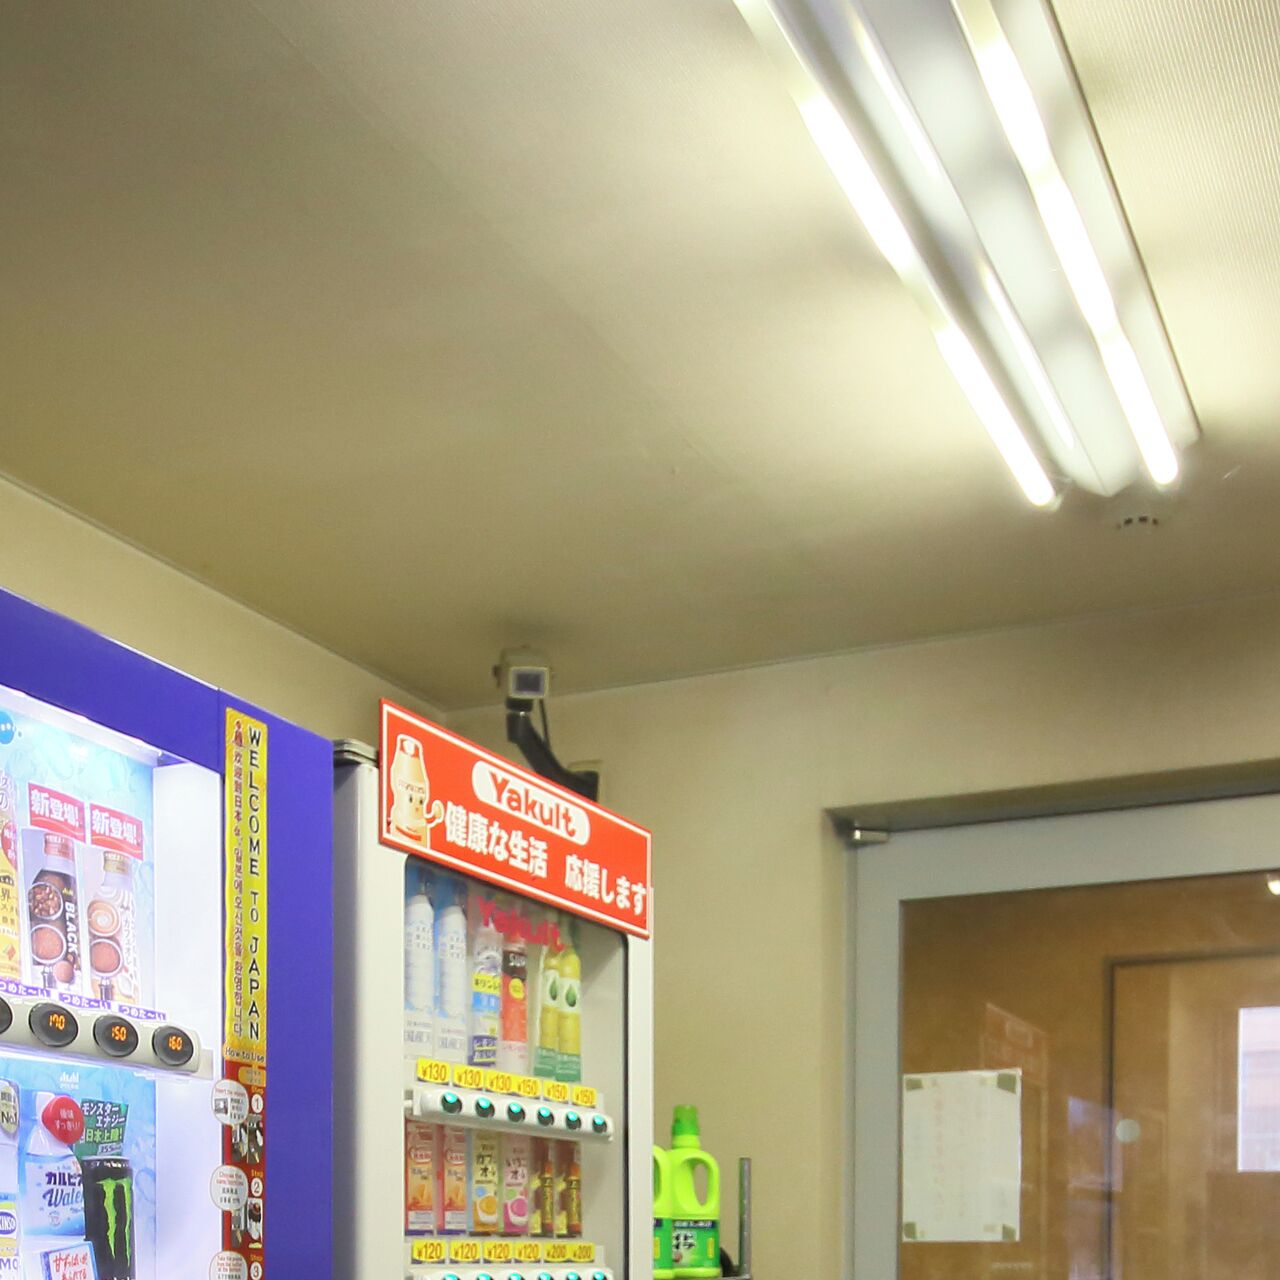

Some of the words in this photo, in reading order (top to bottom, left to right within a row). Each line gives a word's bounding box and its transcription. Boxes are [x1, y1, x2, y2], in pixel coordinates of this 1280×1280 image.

[248, 726, 262, 877] WELCOME
[488, 770, 578, 839] Yakult
[443, 801, 549, 880] 健康な生活
[564, 853, 647, 916] 応援します
[63, 900, 78, 956] BLACK
[249, 891, 260, 923] TO
[248, 936, 261, 1041] JAPAN
[109, 1025, 127, 1041] 150
[166, 1035, 183, 1051] 160
